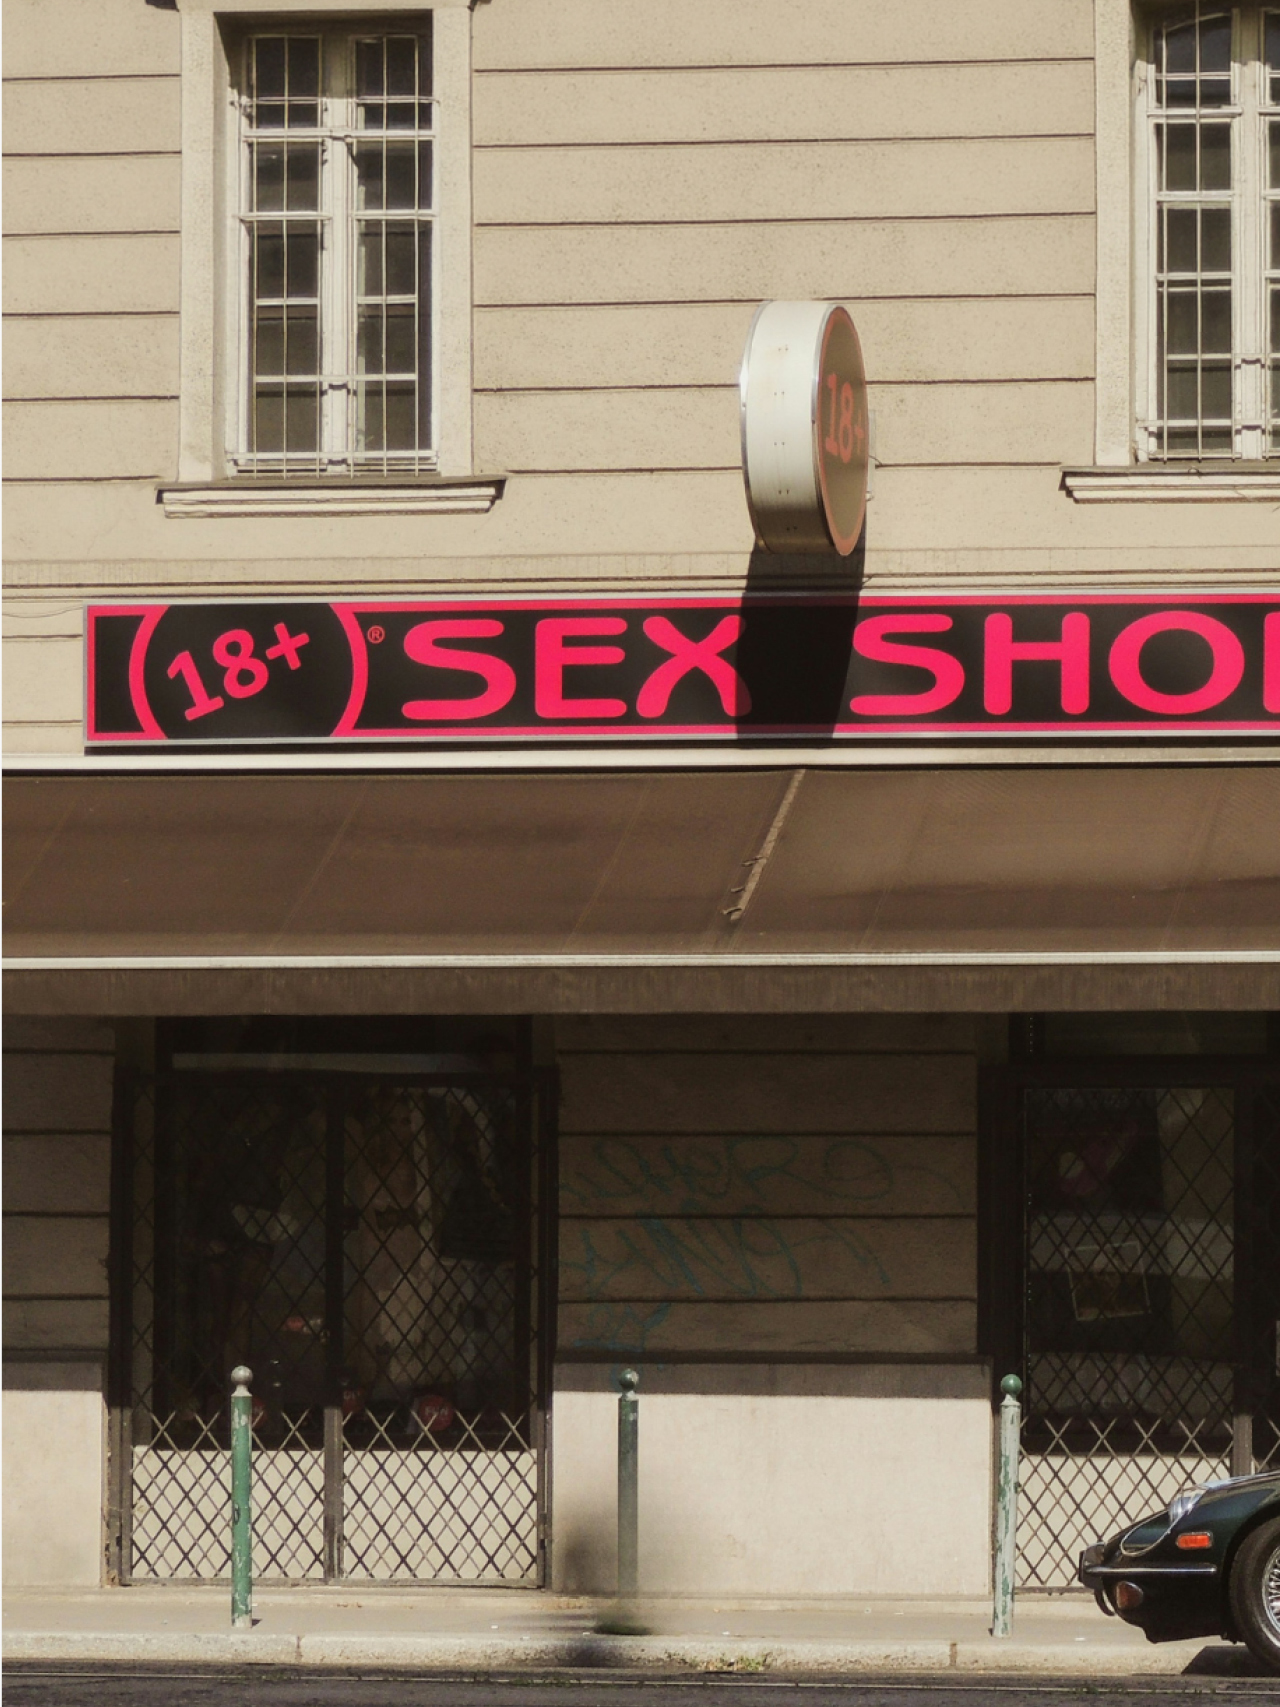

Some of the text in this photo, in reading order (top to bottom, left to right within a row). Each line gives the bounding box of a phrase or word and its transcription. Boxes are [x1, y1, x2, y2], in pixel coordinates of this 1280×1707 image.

[825, 372, 864, 463] 18+
[166, 621, 310, 721] 18+
[401, 615, 751, 720] SEX
